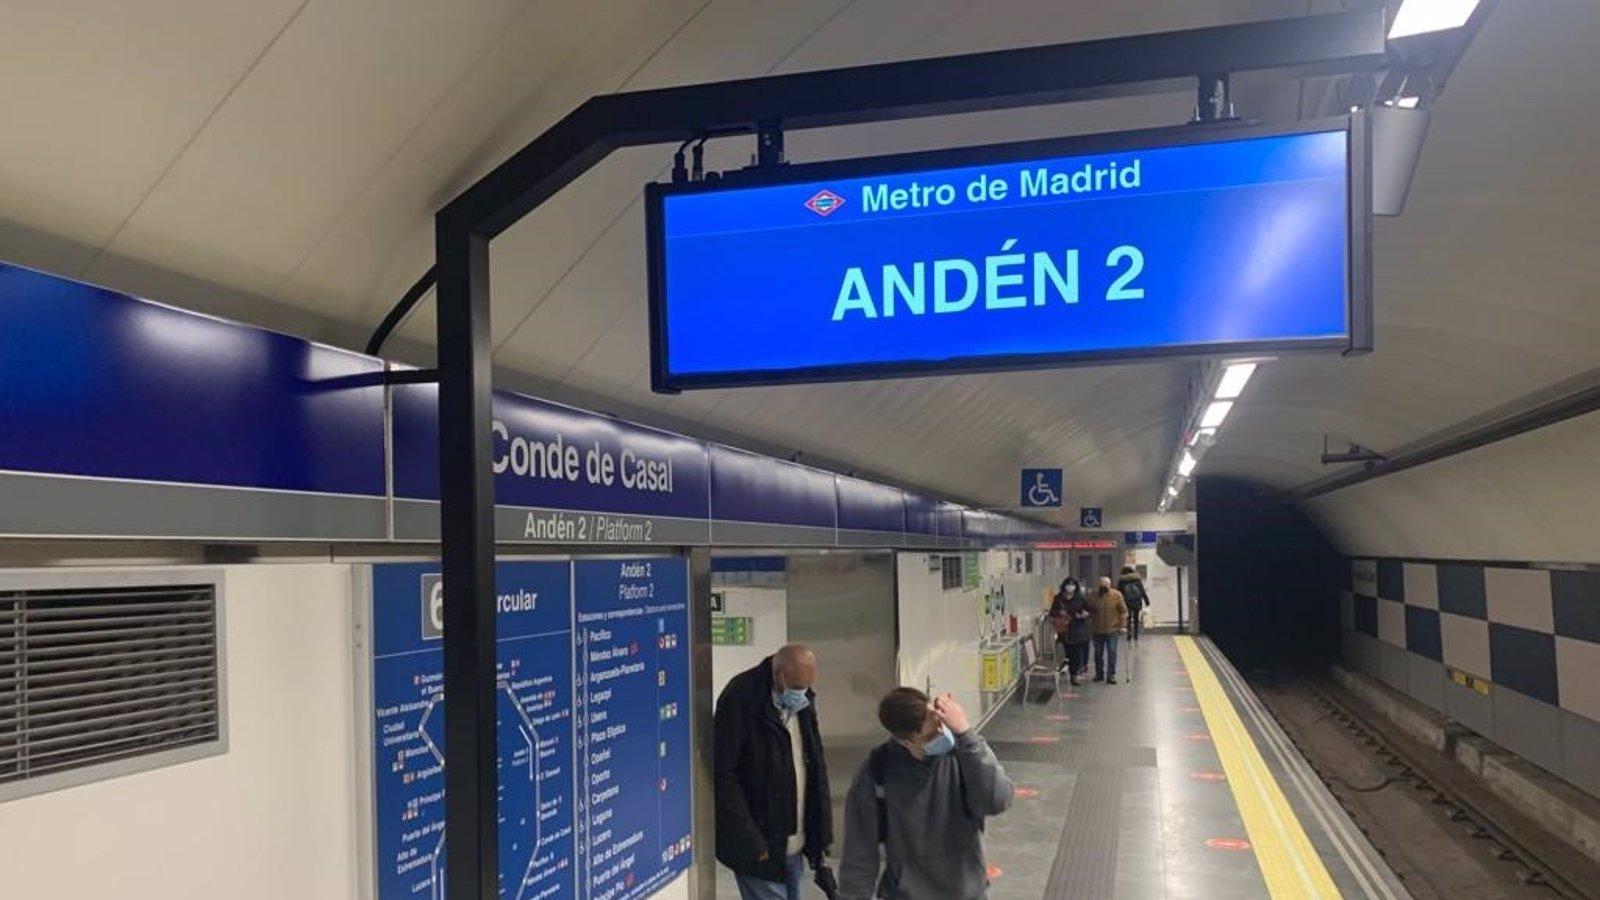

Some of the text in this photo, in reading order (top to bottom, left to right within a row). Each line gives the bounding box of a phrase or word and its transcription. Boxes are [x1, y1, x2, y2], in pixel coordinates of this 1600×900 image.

[861, 160, 1141, 213] Metro de Madrid
[831, 238, 1145, 321] ANDÉN 2
[492, 420, 673, 493] Conde de Casal
[524, 512, 575, 539] Andén
[578, 518, 587, 539] 2
[596, 516, 643, 541] Platform
[644, 520, 652, 541] 2
[621, 562, 652, 577] Andén 2
[497, 589, 538, 613] rcular
[619, 583, 654, 599] Platform 2
